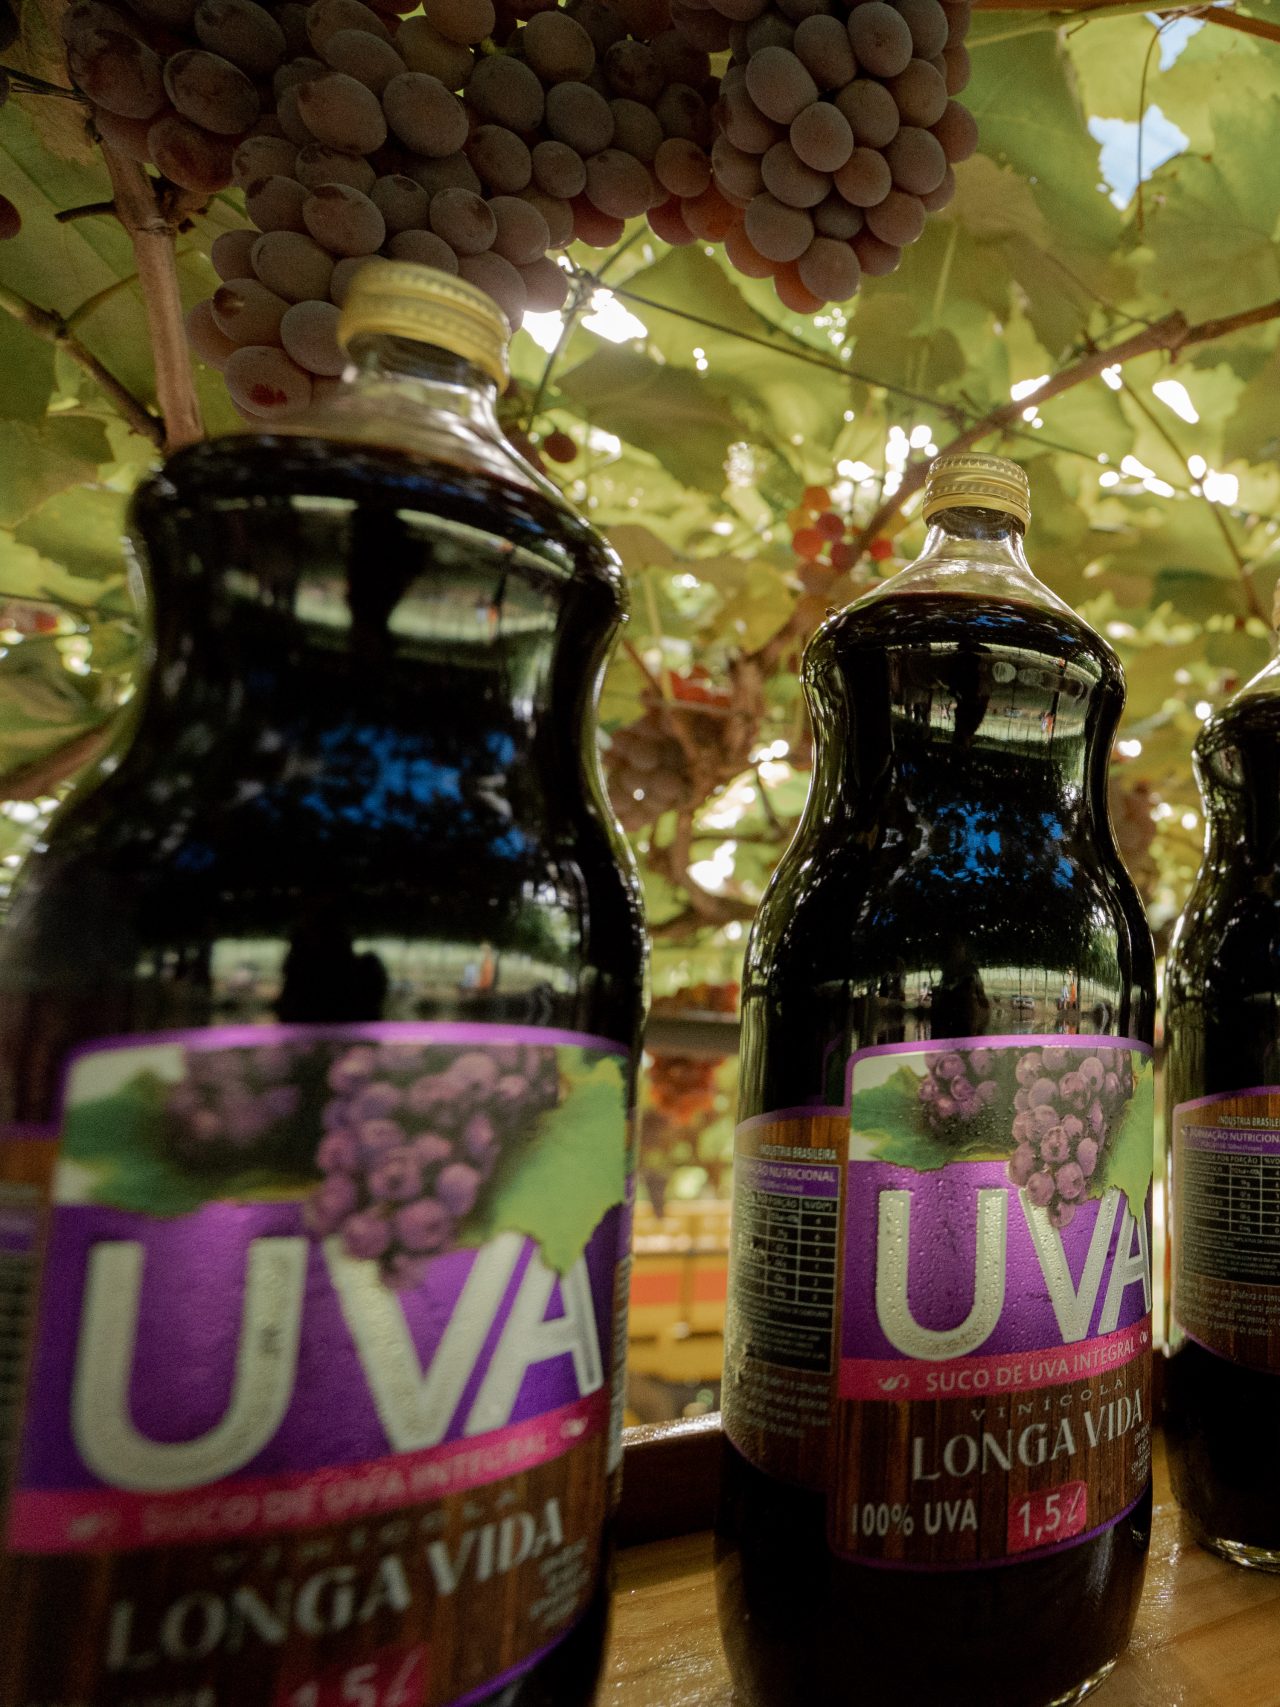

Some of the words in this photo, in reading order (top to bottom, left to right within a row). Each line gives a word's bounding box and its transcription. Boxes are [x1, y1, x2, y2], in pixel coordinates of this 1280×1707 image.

[768, 1166, 836, 1182] NUTRICIONAL
[877, 1187, 1152, 1361] UVA
[70, 1230, 604, 1493] UVA
[926, 1368, 990, 1393] SUCO
[995, 1364, 1023, 1386] DE
[1029, 1357, 1069, 1382] UVA
[1073, 1336, 1136, 1374] INTEGRAL
[912, 1416, 1077, 1481] LONGA
[1083, 1387, 1143, 1449] VIDA
[851, 1501, 914, 1539] 100%
[924, 1497, 979, 1536] UVA
[107, 1555, 412, 1673] LONGA
[426, 1498, 565, 1598] VIDA
